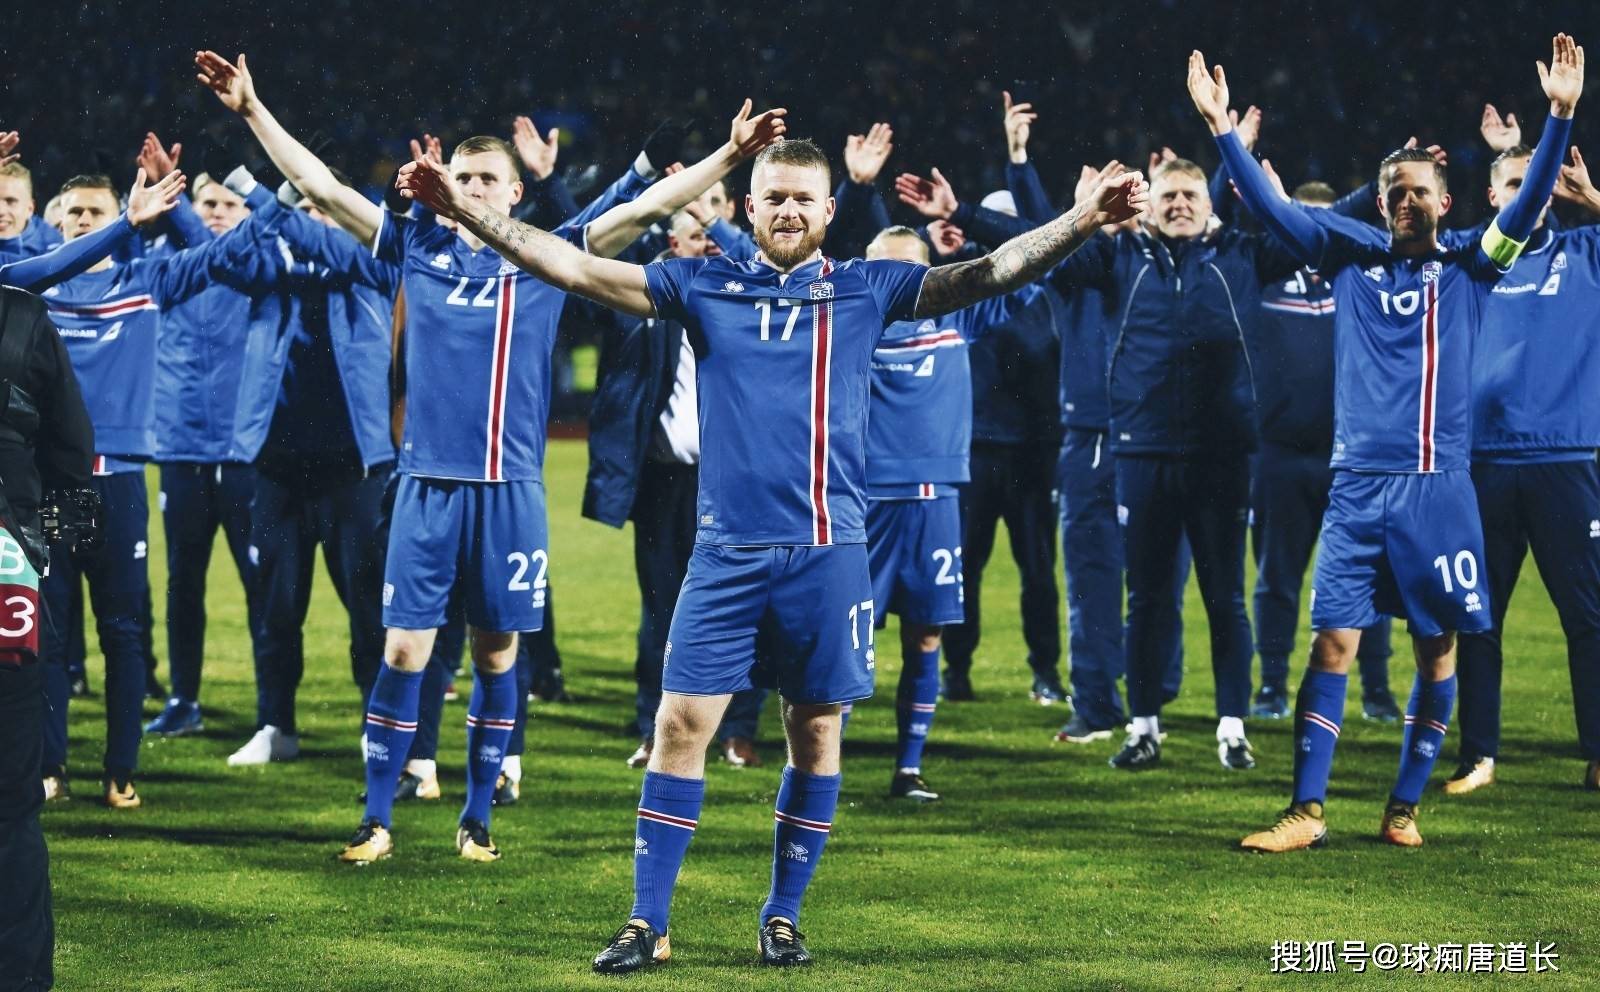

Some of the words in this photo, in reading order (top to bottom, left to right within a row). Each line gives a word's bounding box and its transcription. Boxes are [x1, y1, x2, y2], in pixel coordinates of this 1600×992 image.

[446, 275, 497, 308] 22
[1377, 289, 1420, 316] 10
[754, 298, 802, 341] 17
[507, 549, 548, 592] 22
[1433, 549, 1478, 593] 10
[0, 595, 36, 638] 3
[848, 599, 875, 650] 17
